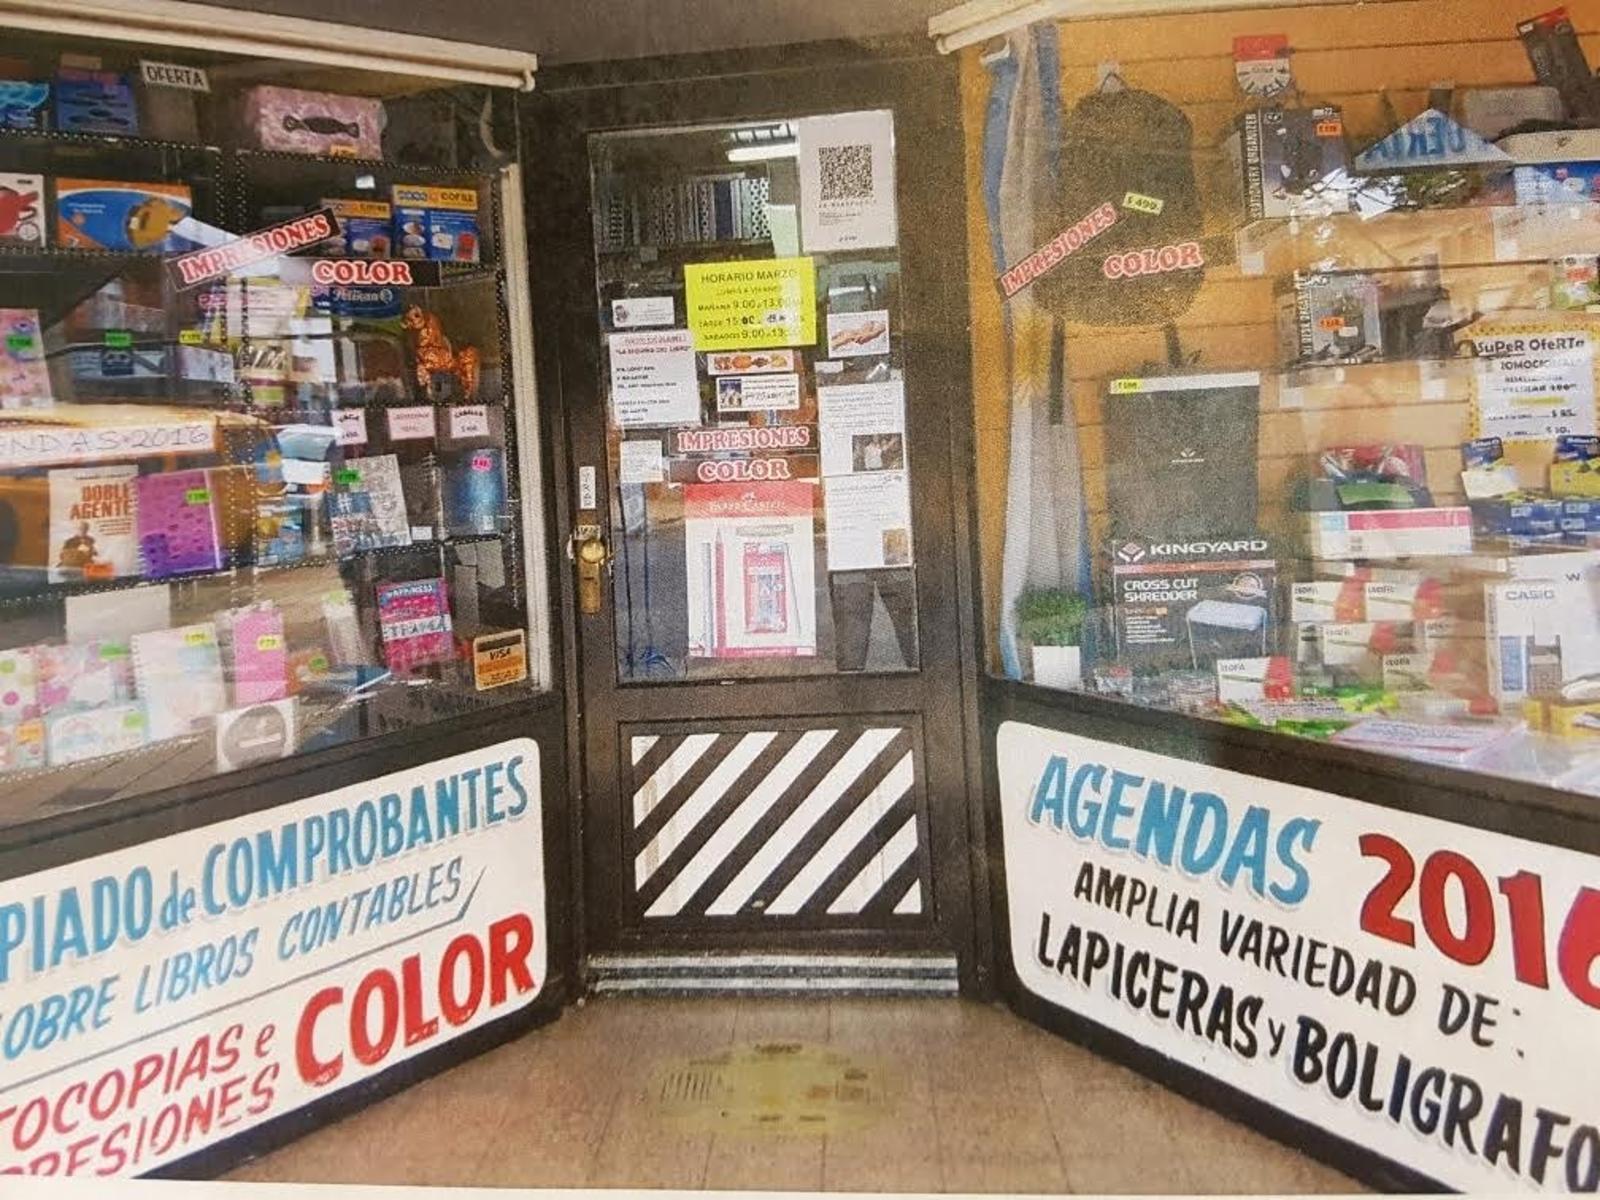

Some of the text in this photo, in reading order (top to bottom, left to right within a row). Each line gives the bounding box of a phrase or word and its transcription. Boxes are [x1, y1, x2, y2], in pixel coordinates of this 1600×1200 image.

[146, 65, 204, 87] OFERTA
[178, 215, 330, 283] IMPRSIONES
[1001, 203, 1118, 296] IMPRESIONES
[1104, 242, 1203, 278] COLOR
[312, 260, 413, 285] COLOR
[701, 272, 754, 284] HORARIO
[678, 427, 809, 452] IMPRESIONES
[698, 459, 791, 481] COLOR
[1150, 540, 1268, 556] KINGYARD
[1123, 578, 1200, 593] CROSS CUT
[1124, 590, 1198, 603] SHREDDER
[1030, 755, 1322, 905] AGENDAS
[0, 755, 527, 982] PIADO de COMPROBANTES
[1074, 862, 1200, 944] AMPLIA
[1220, 909, 1416, 1016] VARIEDAD
[0, 856, 462, 1061] OBRE LIBROS CONTABLES
[295, 913, 534, 1087] COLOR
[255, 1024, 276, 1057] e
[1038, 913, 1263, 1062] LAPICERAS
[1293, 1015, 1600, 1194] BOLIGRAFO
